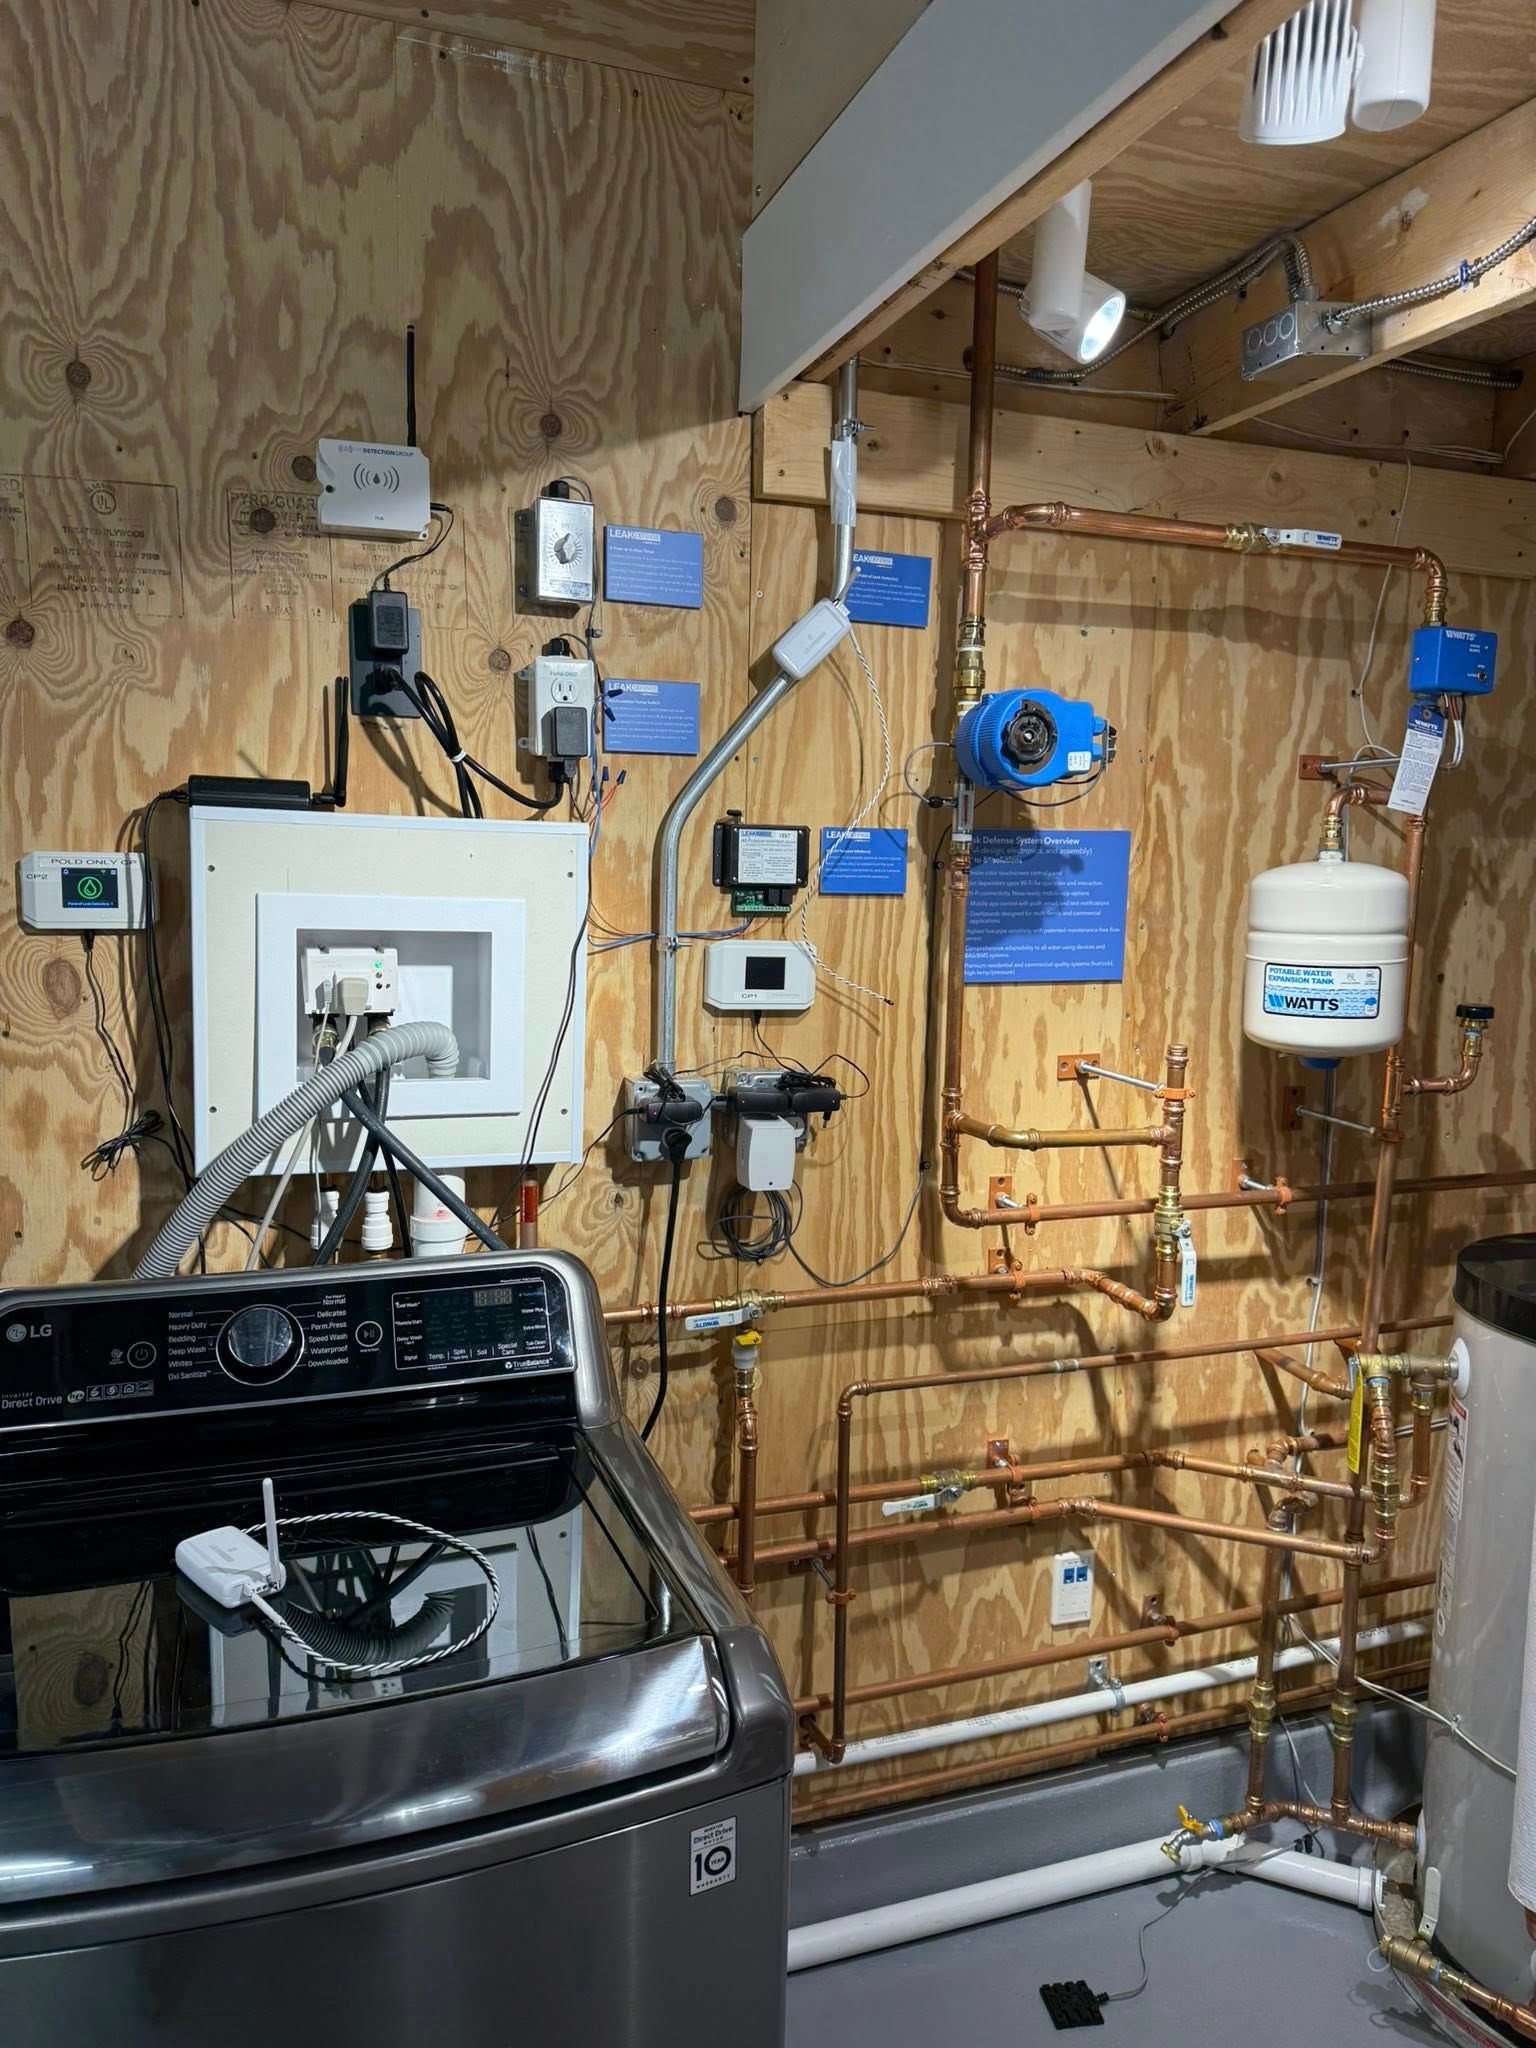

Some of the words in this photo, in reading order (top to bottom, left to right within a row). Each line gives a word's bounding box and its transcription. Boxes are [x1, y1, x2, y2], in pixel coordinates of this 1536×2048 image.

[230, 492, 318, 511] PYRO-GUAR
[1445, 629, 1477, 641] WATTS
[983, 836, 1015, 845] Defense
[1016, 836, 1043, 847] System
[1044, 836, 1080, 845] Overview
[1060, 847, 1093, 856] assembly)
[1268, 967, 1302, 977] POTABLE
[1303, 969, 1333, 977] WATER
[1268, 975, 1310, 984] EXPANSION
[1311, 976, 1335, 985] TANK
[1285, 995, 1340, 1011] WATTS
[322, 1298, 346, 1306] Normal
[168, 1311, 194, 1319] Normal
[316, 1310, 347, 1318] Delicates
[190, 1321, 207, 1329] Duty
[30, 1324, 52, 1338] LG
[168, 1335, 197, 1343] Bedding
[308, 1335, 329, 1343] Speed
[329, 1333, 348, 1341] Wash
[168, 1348, 187, 1356] Deep
[186, 1346, 207, 1354] Wash
[310, 1345, 348, 1354] Waterproof
[497, 1342, 518, 1350] Special
[307, 1357, 349, 1367] Downloaded
[1, 1397, 33, 1409] Direct
[35, 1395, 63, 1407] Drive
[693, 1832, 714, 1844] Direct
[714, 1826, 733, 1838] Drive
[694, 1845, 732, 1882] 10
